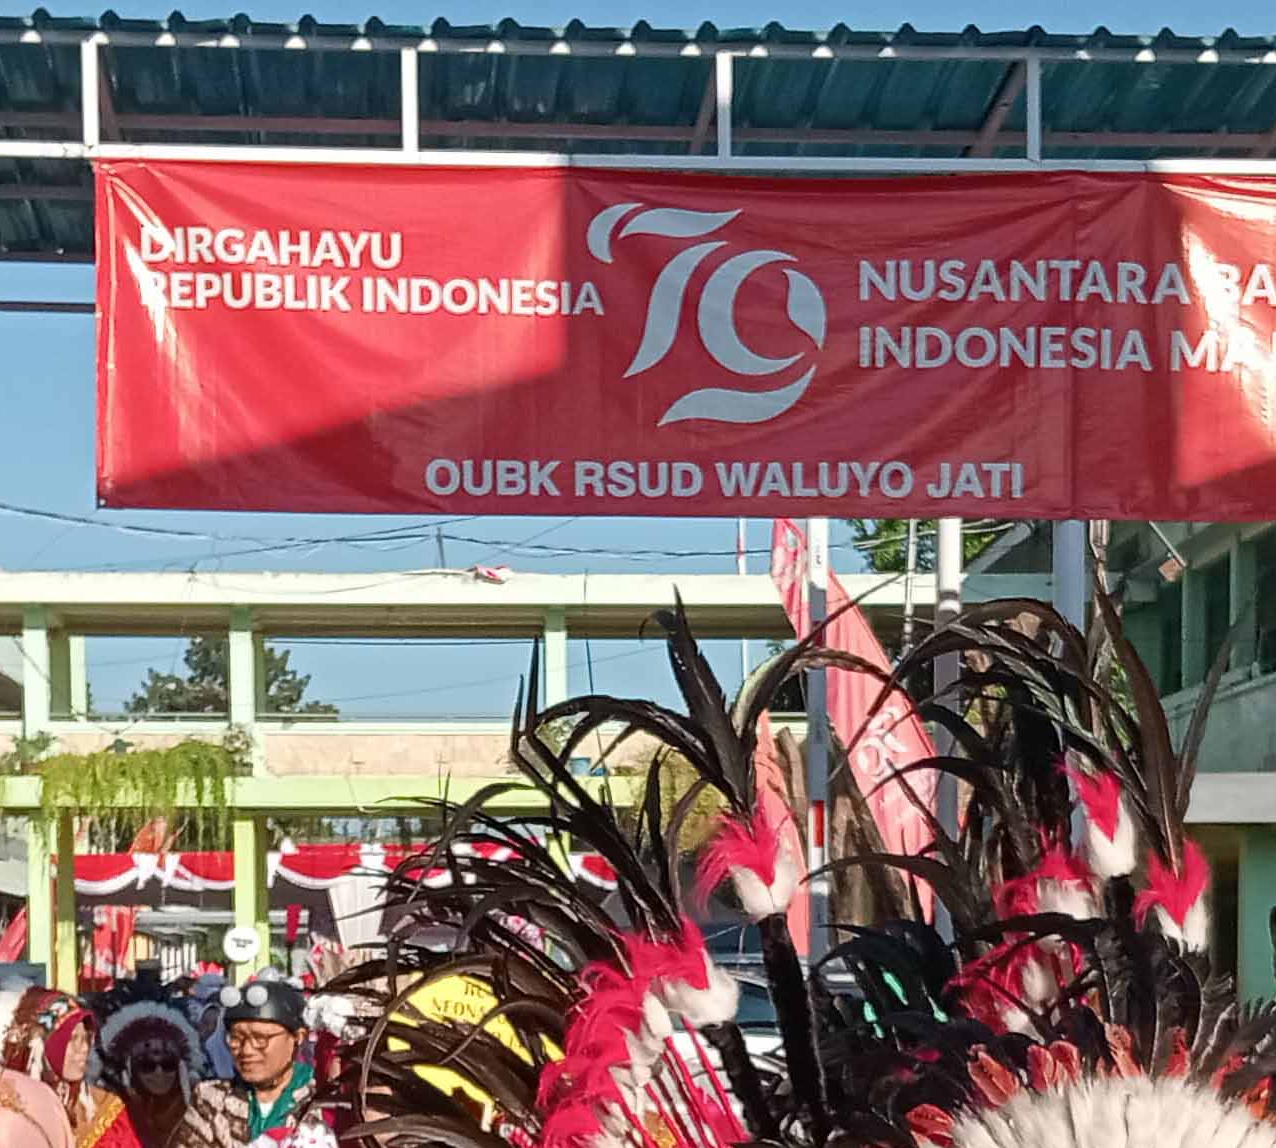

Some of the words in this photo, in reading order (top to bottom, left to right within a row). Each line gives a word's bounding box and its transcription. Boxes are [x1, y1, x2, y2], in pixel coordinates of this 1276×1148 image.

[140, 226, 402, 269] DIRGAHAYU
[143, 272, 353, 313] REPUBLIK
[362, 278, 605, 317] INDONESIA
[859, 260, 1191, 305] NUSANTARA
[859, 326, 1153, 372] INDONESIA
[425, 459, 560, 497] OUBK
[574, 460, 703, 497] RSUD
[716, 462, 915, 498] WALUYO
[927, 463, 1024, 499] JATI
